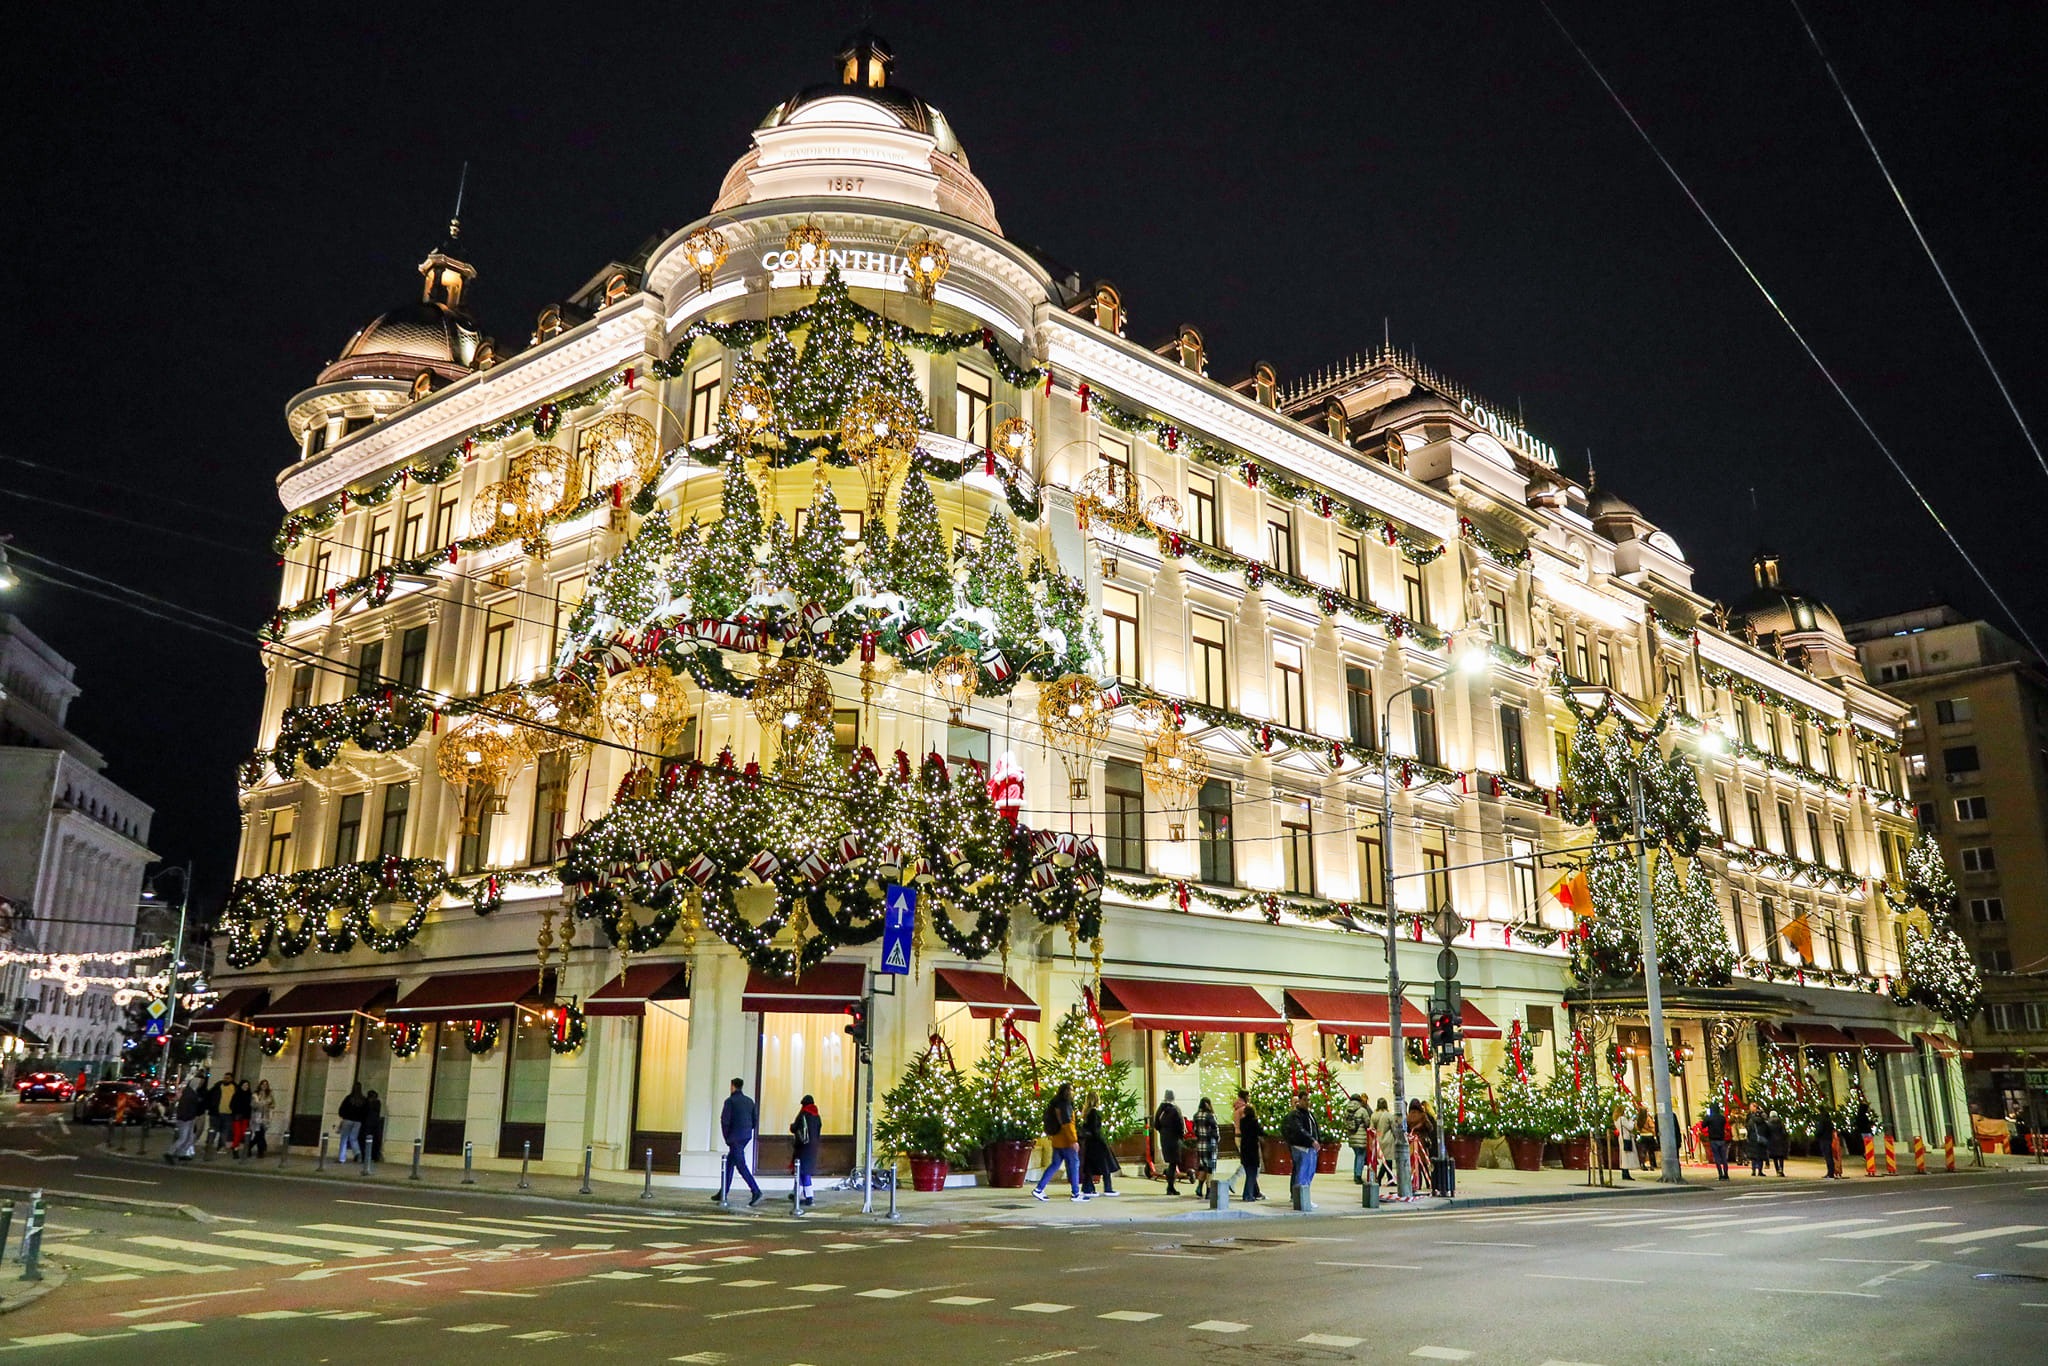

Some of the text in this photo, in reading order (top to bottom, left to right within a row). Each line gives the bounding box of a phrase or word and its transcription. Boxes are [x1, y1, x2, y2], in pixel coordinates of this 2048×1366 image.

[827, 176, 865, 192] 1867
[761, 247, 914, 276] CORINTHIA
[1461, 398, 1559, 469] CORINTHIA
